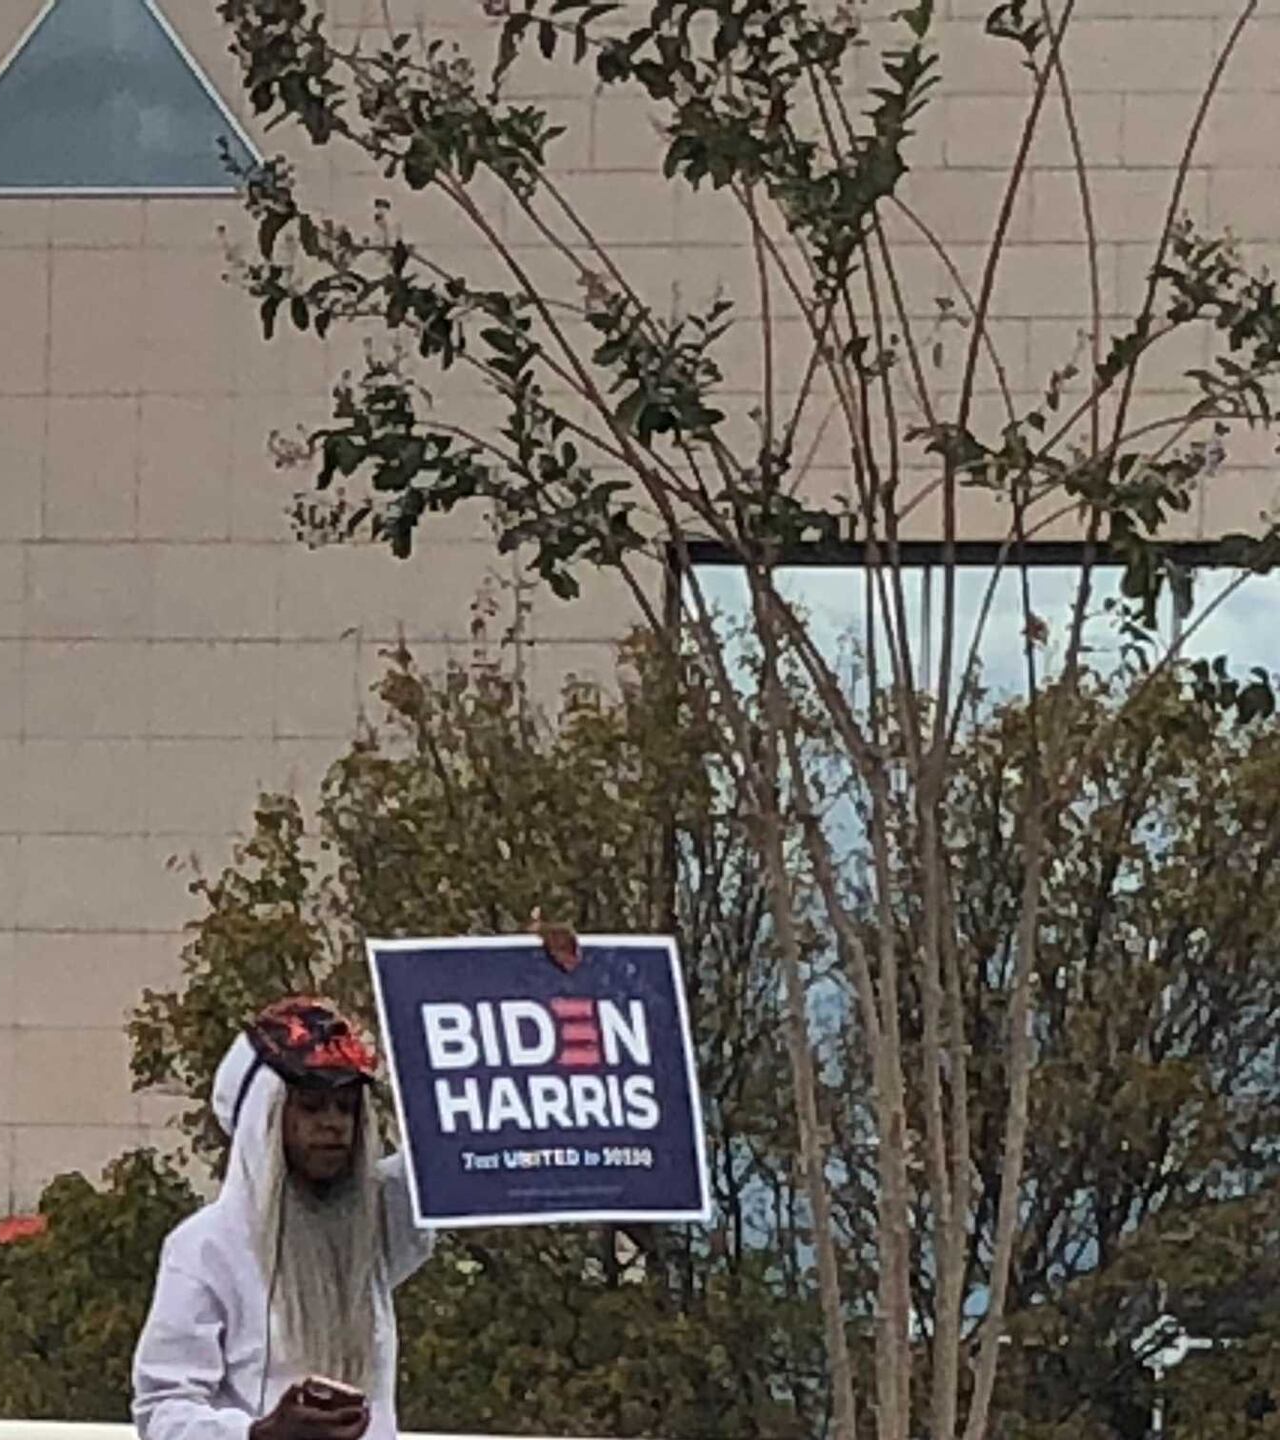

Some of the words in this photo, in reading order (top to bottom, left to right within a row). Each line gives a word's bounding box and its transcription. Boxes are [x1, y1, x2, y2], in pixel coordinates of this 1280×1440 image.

[421, 997, 652, 1069] BIDEN
[435, 1074, 660, 1132] HARRIS
[503, 1148, 580, 1168] UNITED
